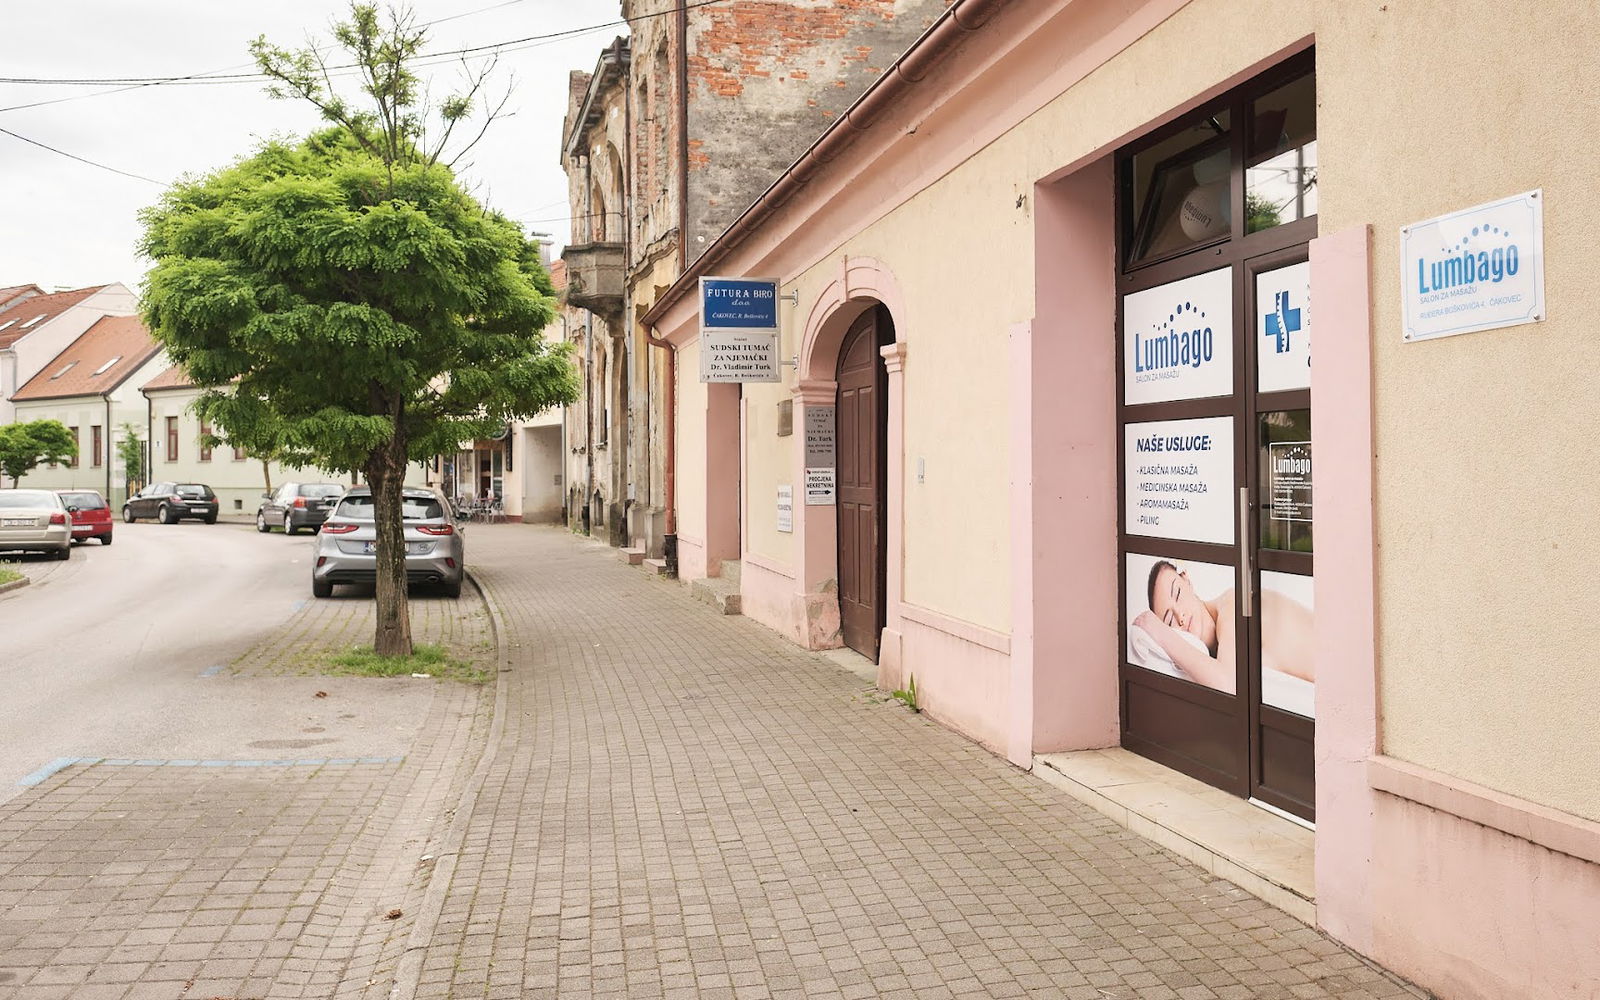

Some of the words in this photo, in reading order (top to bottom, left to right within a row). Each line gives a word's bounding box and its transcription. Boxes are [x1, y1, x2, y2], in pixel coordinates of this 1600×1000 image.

[1418, 244, 1519, 294] Lumbago
[707, 288, 749, 298] FUTURA
[753, 290, 773, 298] BIRO
[1419, 293, 1440, 304] SALON
[1440, 291, 1449, 300] ZA
[1450, 286, 1477, 298] MASAŽU
[1135, 327, 1213, 373] Lumbago
[1136, 374, 1151, 383] SALON
[1151, 373, 1158, 381] ZA
[1159, 370, 1180, 380] MASAŽU
[1136, 434, 1164, 452] NAŠE
[1165, 435, 1212, 451] USLUGE:
[1170, 464, 1198, 475] MASAŽA
[1273, 455, 1311, 475] Lumbago
[1179, 481, 1208, 493] MASAŽA
